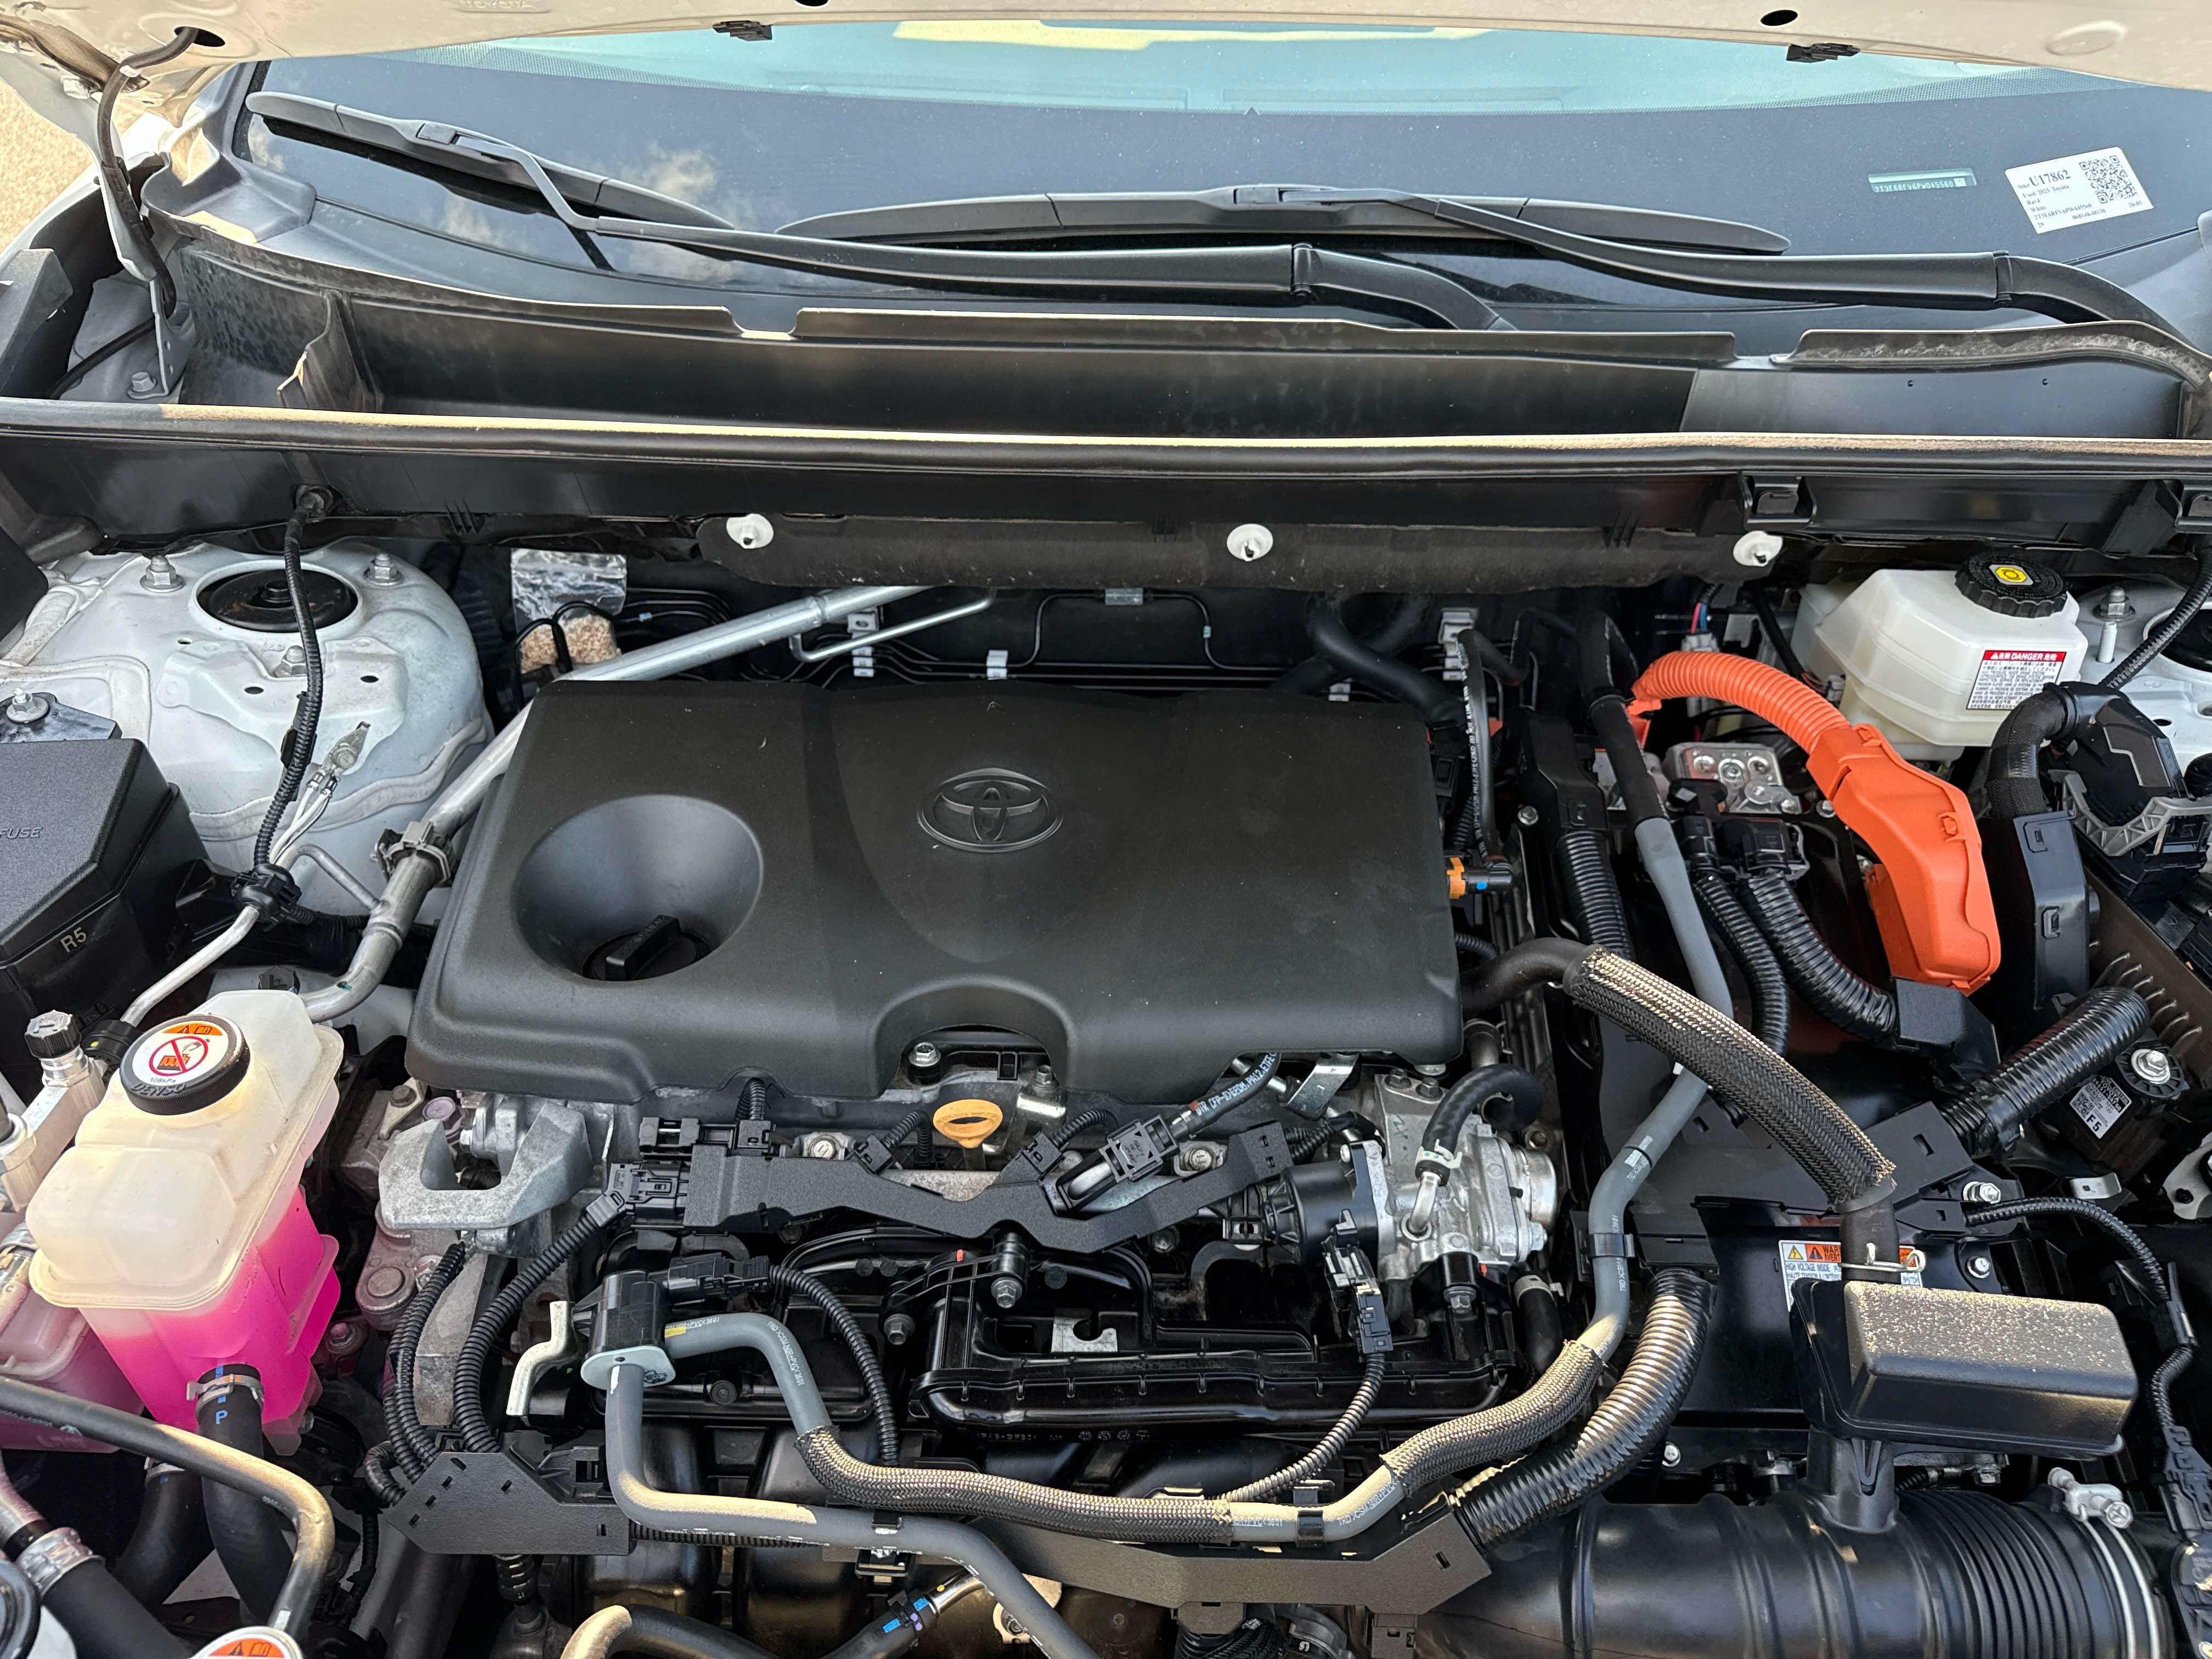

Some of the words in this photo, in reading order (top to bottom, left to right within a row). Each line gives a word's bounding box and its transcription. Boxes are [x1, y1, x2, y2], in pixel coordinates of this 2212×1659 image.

[2029, 170, 2072, 187] U17862
[60, 927, 87, 953] R5
[131, 1083, 186, 1097] DENSO
[2100, 1079, 2120, 1102] TOYOTA
[767, 1321, 777, 1331] TRD
[216, 1410, 228, 1425] P
